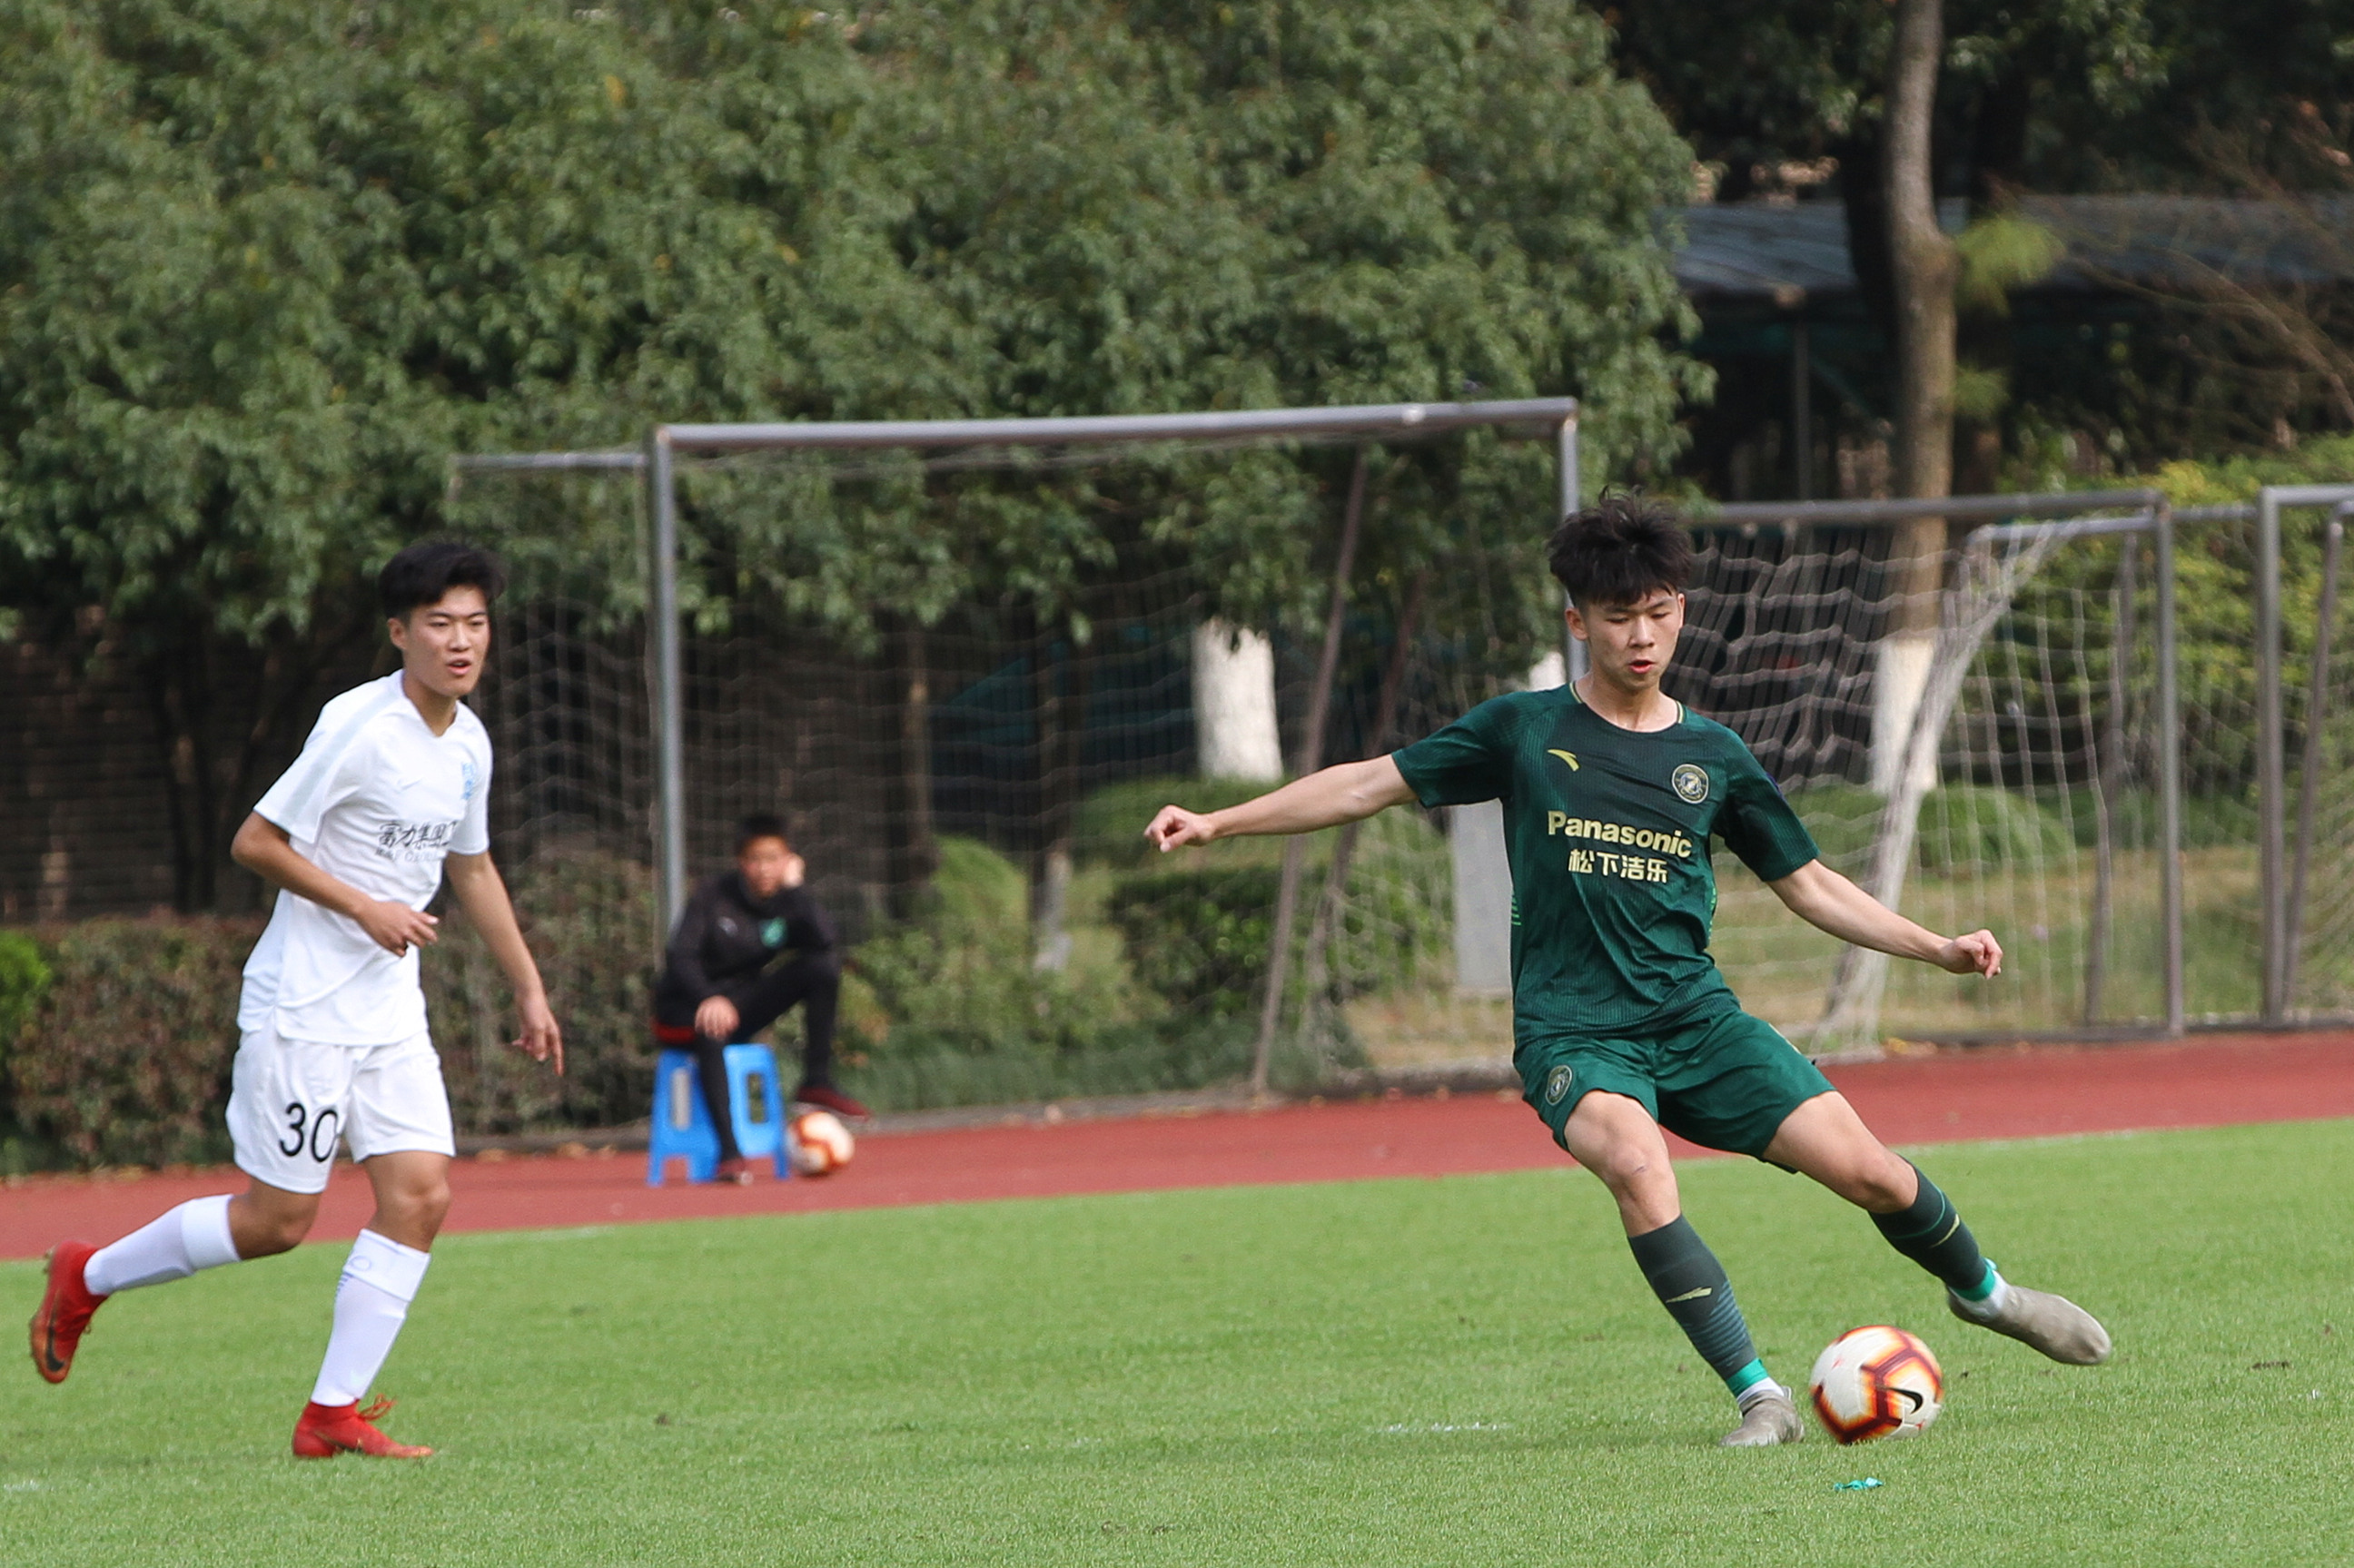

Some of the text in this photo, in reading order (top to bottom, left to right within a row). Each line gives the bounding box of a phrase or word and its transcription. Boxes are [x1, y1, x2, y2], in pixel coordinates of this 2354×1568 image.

[1548, 811, 1693, 858] Panasonic
[1568, 849, 1667, 883] 松下洁乐
[278, 1102, 339, 1163] 30
